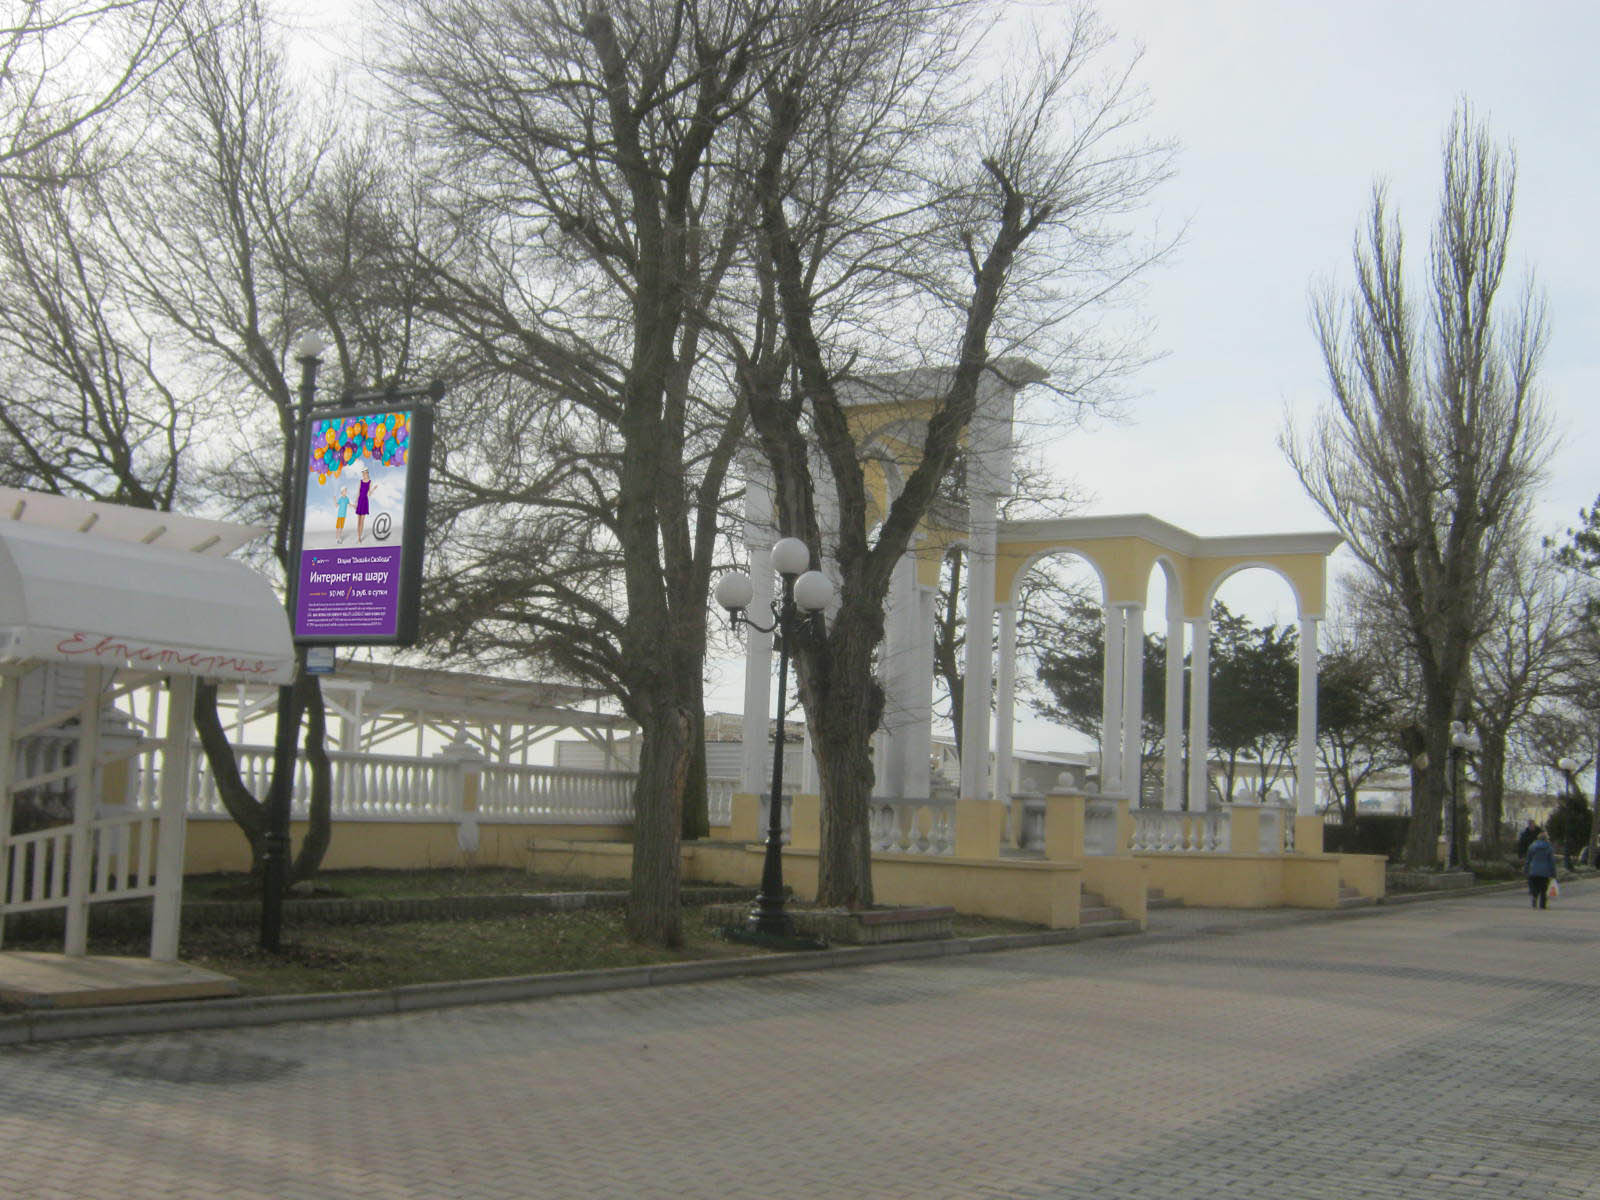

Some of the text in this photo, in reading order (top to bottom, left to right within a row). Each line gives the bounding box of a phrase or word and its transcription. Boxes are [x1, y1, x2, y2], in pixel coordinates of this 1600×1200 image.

[309, 571, 389, 585] Интернет на шару
